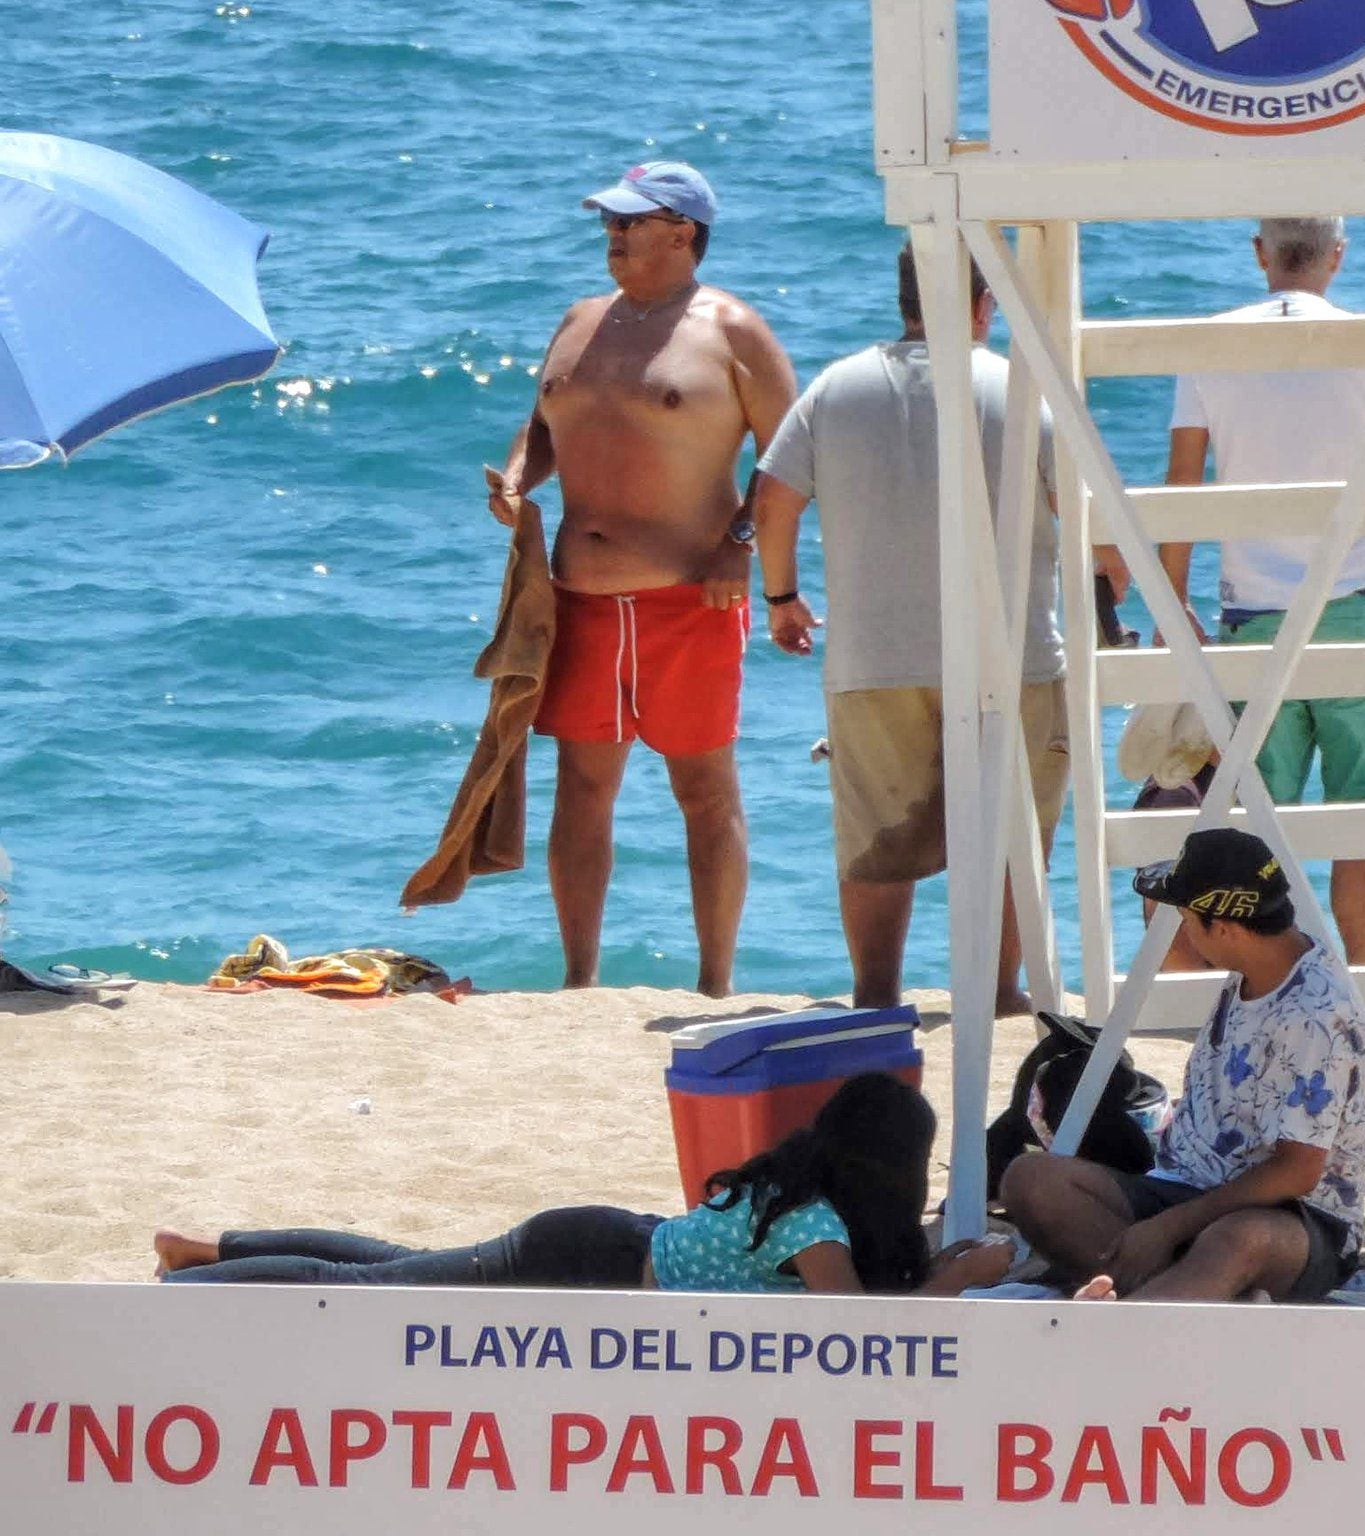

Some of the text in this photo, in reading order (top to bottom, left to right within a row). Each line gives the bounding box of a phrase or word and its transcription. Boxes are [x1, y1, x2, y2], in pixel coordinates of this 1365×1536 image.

[405, 1324, 959, 1377] PLAYA DEL DEPORTE
[250, 1407, 517, 1491] APTA
[548, 1411, 820, 1497] PARA
[853, 1419, 965, 1501] EL
